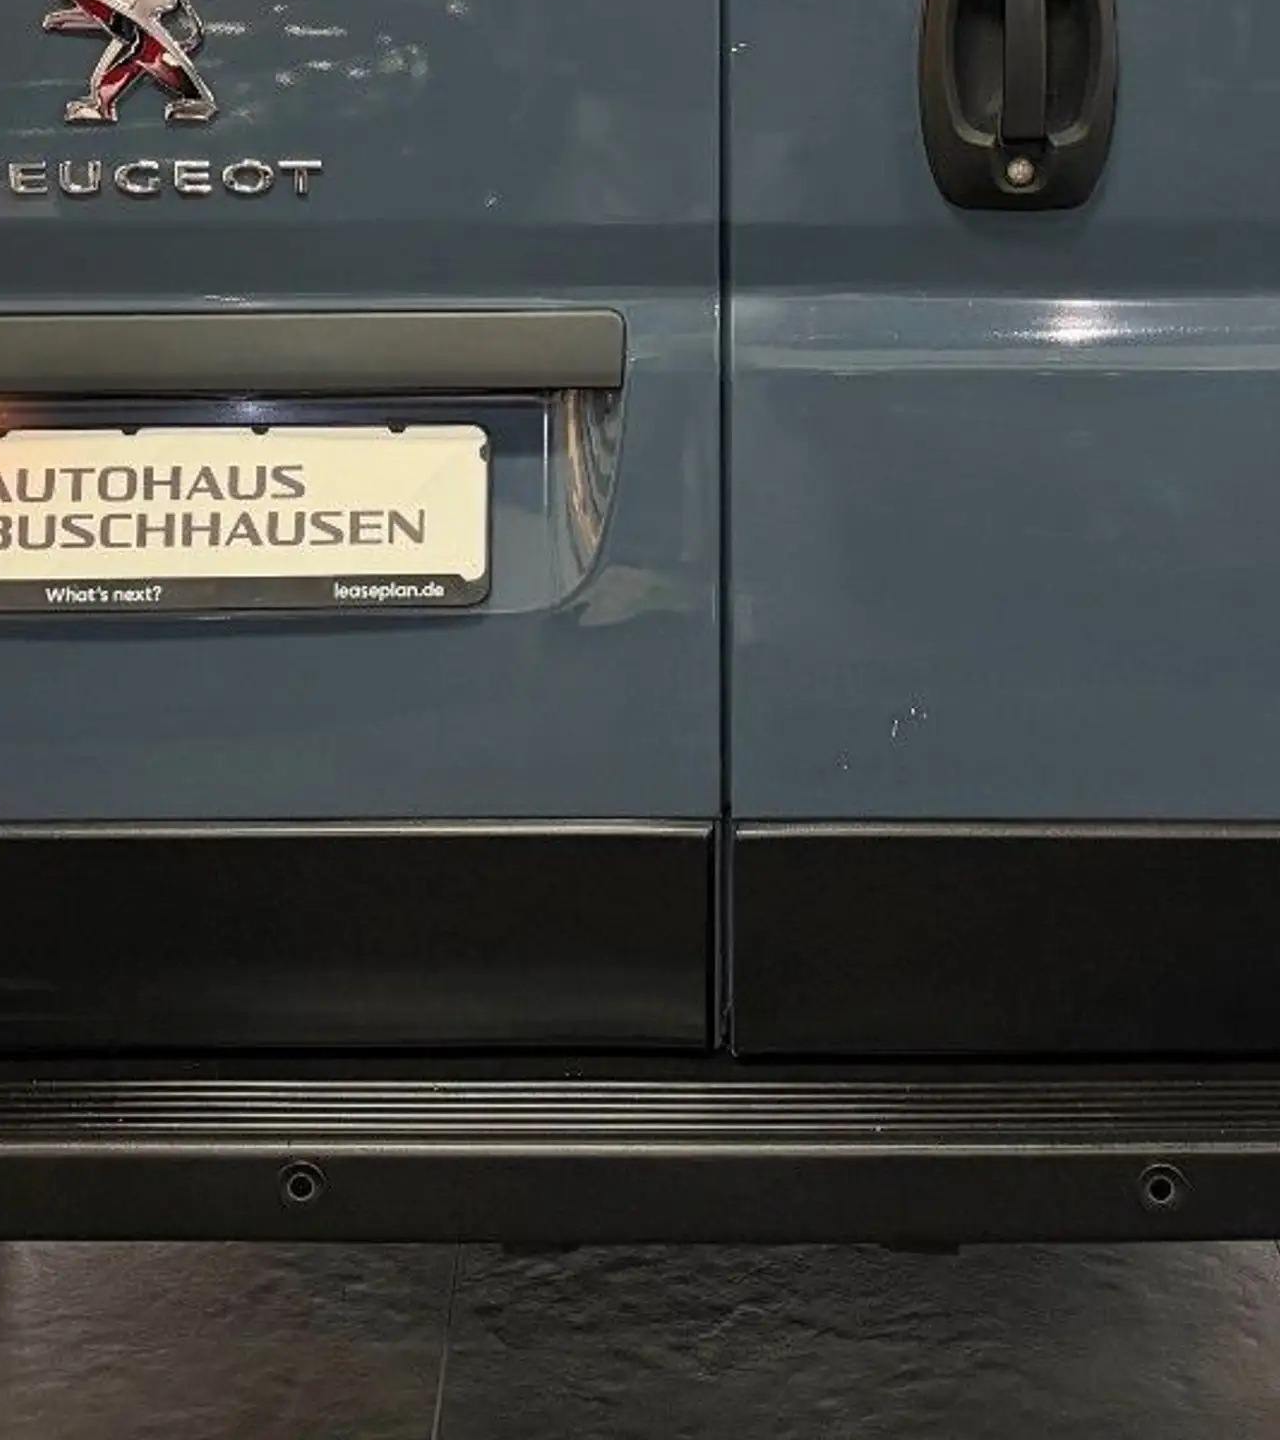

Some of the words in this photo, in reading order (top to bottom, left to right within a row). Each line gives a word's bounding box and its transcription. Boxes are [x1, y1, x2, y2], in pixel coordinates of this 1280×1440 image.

[45, 585, 109, 603] What's
[112, 585, 162, 602] next?
[333, 581, 445, 602] leaseplan.de
